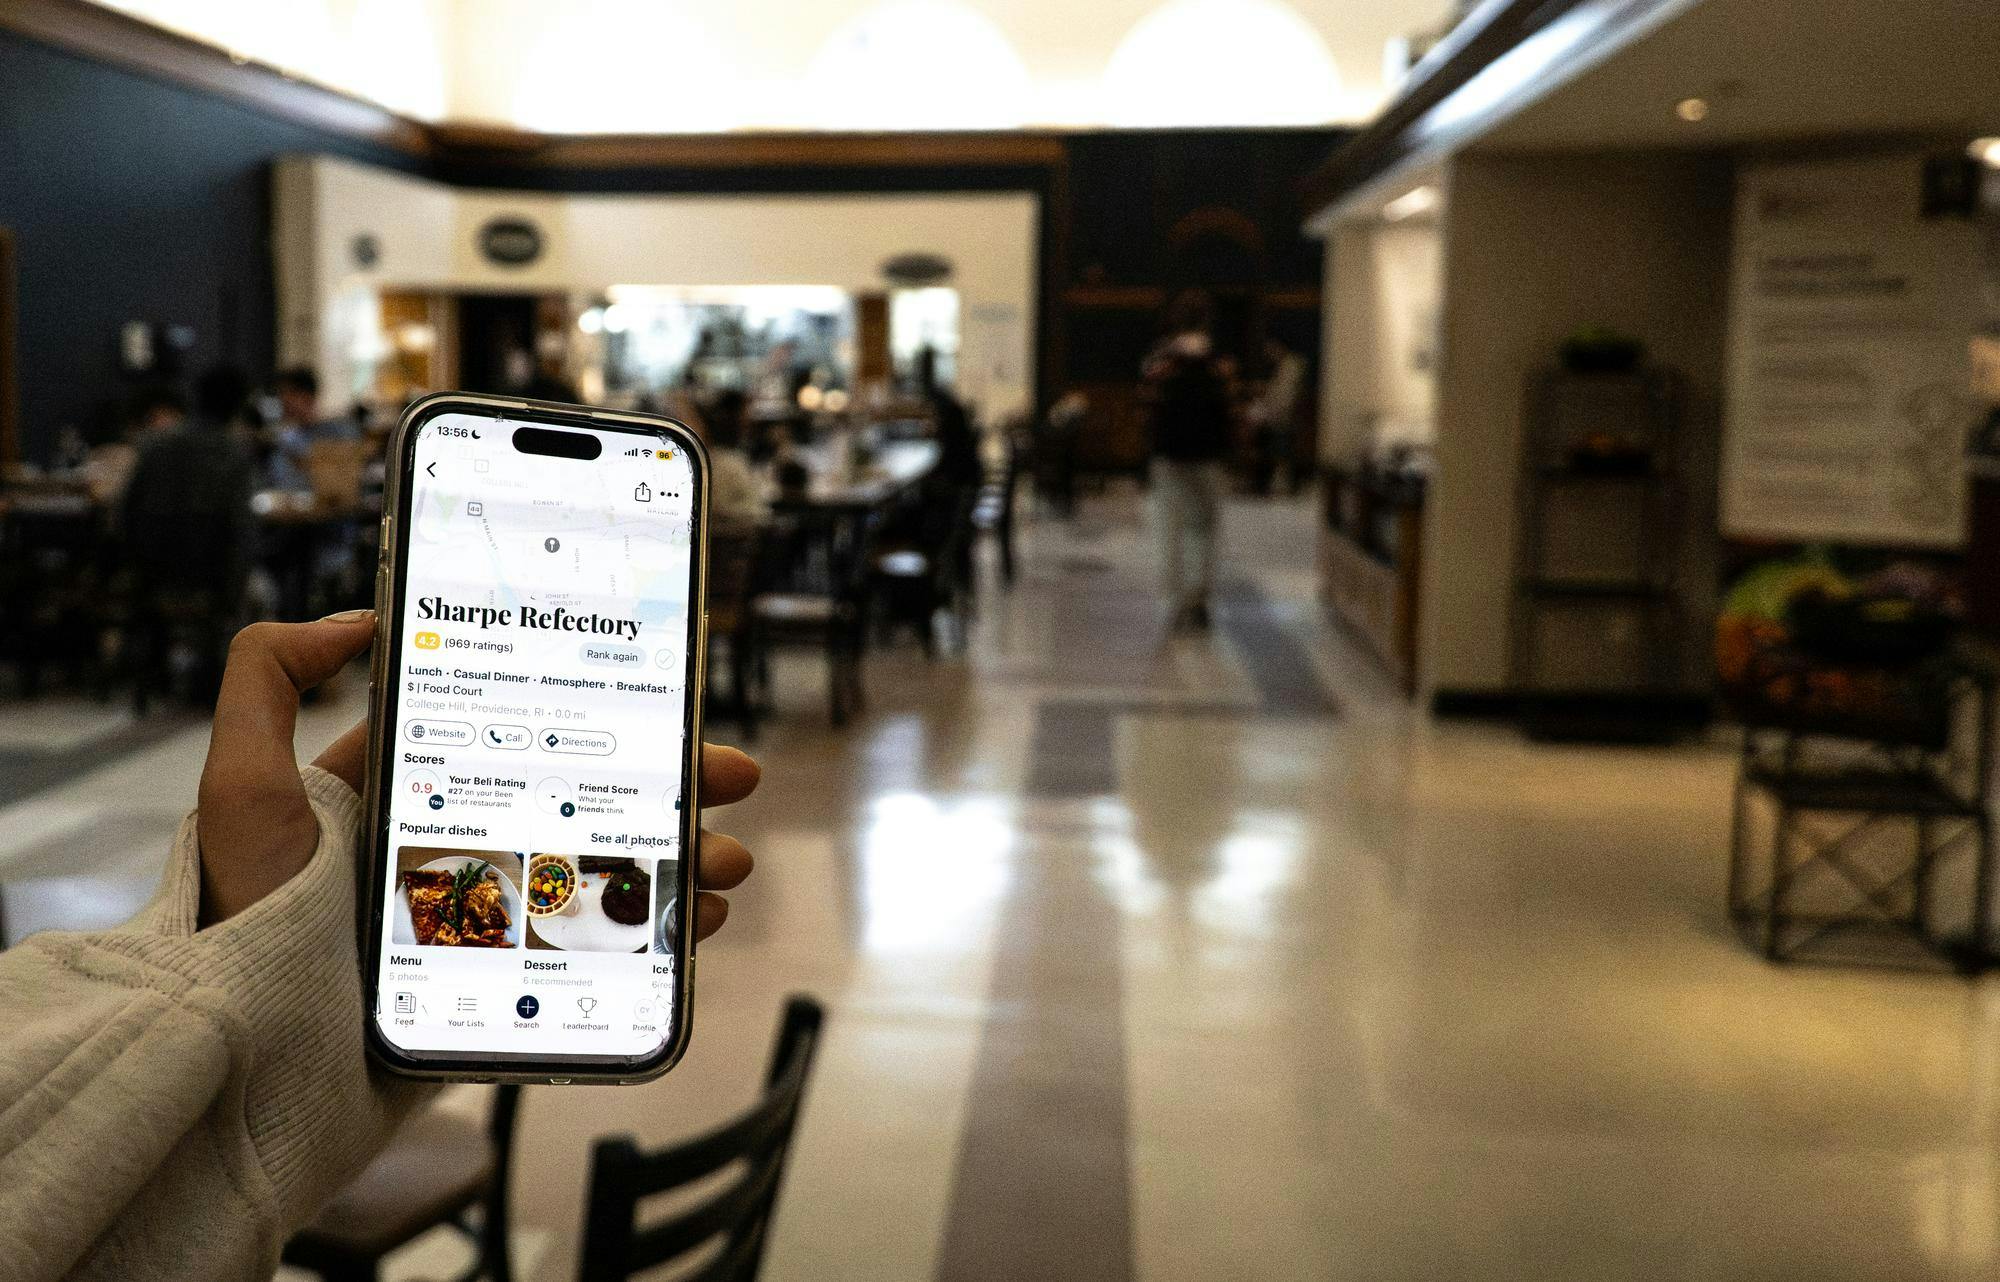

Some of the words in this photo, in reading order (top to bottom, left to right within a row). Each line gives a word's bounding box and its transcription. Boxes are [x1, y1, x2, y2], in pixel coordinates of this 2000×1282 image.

[437, 426, 468, 438] 13:56
[659, 451, 670, 459] 96
[417, 597, 512, 629] Sharpe
[519, 606, 642, 641] Refectory
[418, 636, 436, 646] 4.2
[445, 638, 470, 649] (969
[473, 641, 514, 654] ratings)
[587, 650, 610, 660] Rank
[613, 652, 638, 662] again
[408, 666, 442, 676] Lunch
[454, 669, 491, 680] Casual
[494, 672, 530, 683] Dinner
[540, 676, 606, 689] Atmosphere
[616, 682, 667, 694] Breakfast
[407, 682, 414, 692] $
[424, 684, 450, 694] Food
[453, 686, 483, 696] Court
[406, 698, 446, 712] College
[448, 701, 468, 712] Hill,
[471, 703, 532, 717] Providence,
[534, 708, 544, 717] RI
[555, 709, 571, 719] 0.0
[574, 711, 586, 720] mi
[428, 728, 466, 738] Website
[506, 733, 523, 742] Call
[561, 737, 607, 748] Directions
[404, 753, 445, 764] Scores
[412, 782, 433, 794] 0.9
[449, 776, 472, 786] Your
[474, 777, 492, 787] Beli
[494, 778, 526, 790] Rating
[579, 783, 609, 793] Friend
[611, 786, 638, 795] Score
[476, 791, 492, 800] your
[598, 796, 614, 804] your
[470, 800, 512, 808] restaurants
[578, 805, 604, 814] friends
[606, 807, 624, 815] think
[399, 822, 445, 836] Popular
[448, 824, 488, 837] dishes
[590, 832, 612, 844] See
[614, 834, 628, 844] all
[630, 835, 670, 846] photos
[390, 956, 422, 966] Menu
[524, 960, 568, 970] Dessert
[652, 964, 669, 974] Ice
[389, 973, 395, 981] 5
[397, 973, 429, 982] photos
[531, 976, 593, 987] recommended
[395, 1018, 414, 1026] Feed
[448, 1018, 465, 1027] Your
[466, 1020, 485, 1028] Lists
[514, 1021, 540, 1029] Search
[562, 1022, 609, 1031] Leaderboard
[632, 1024, 656, 1032] Profile
